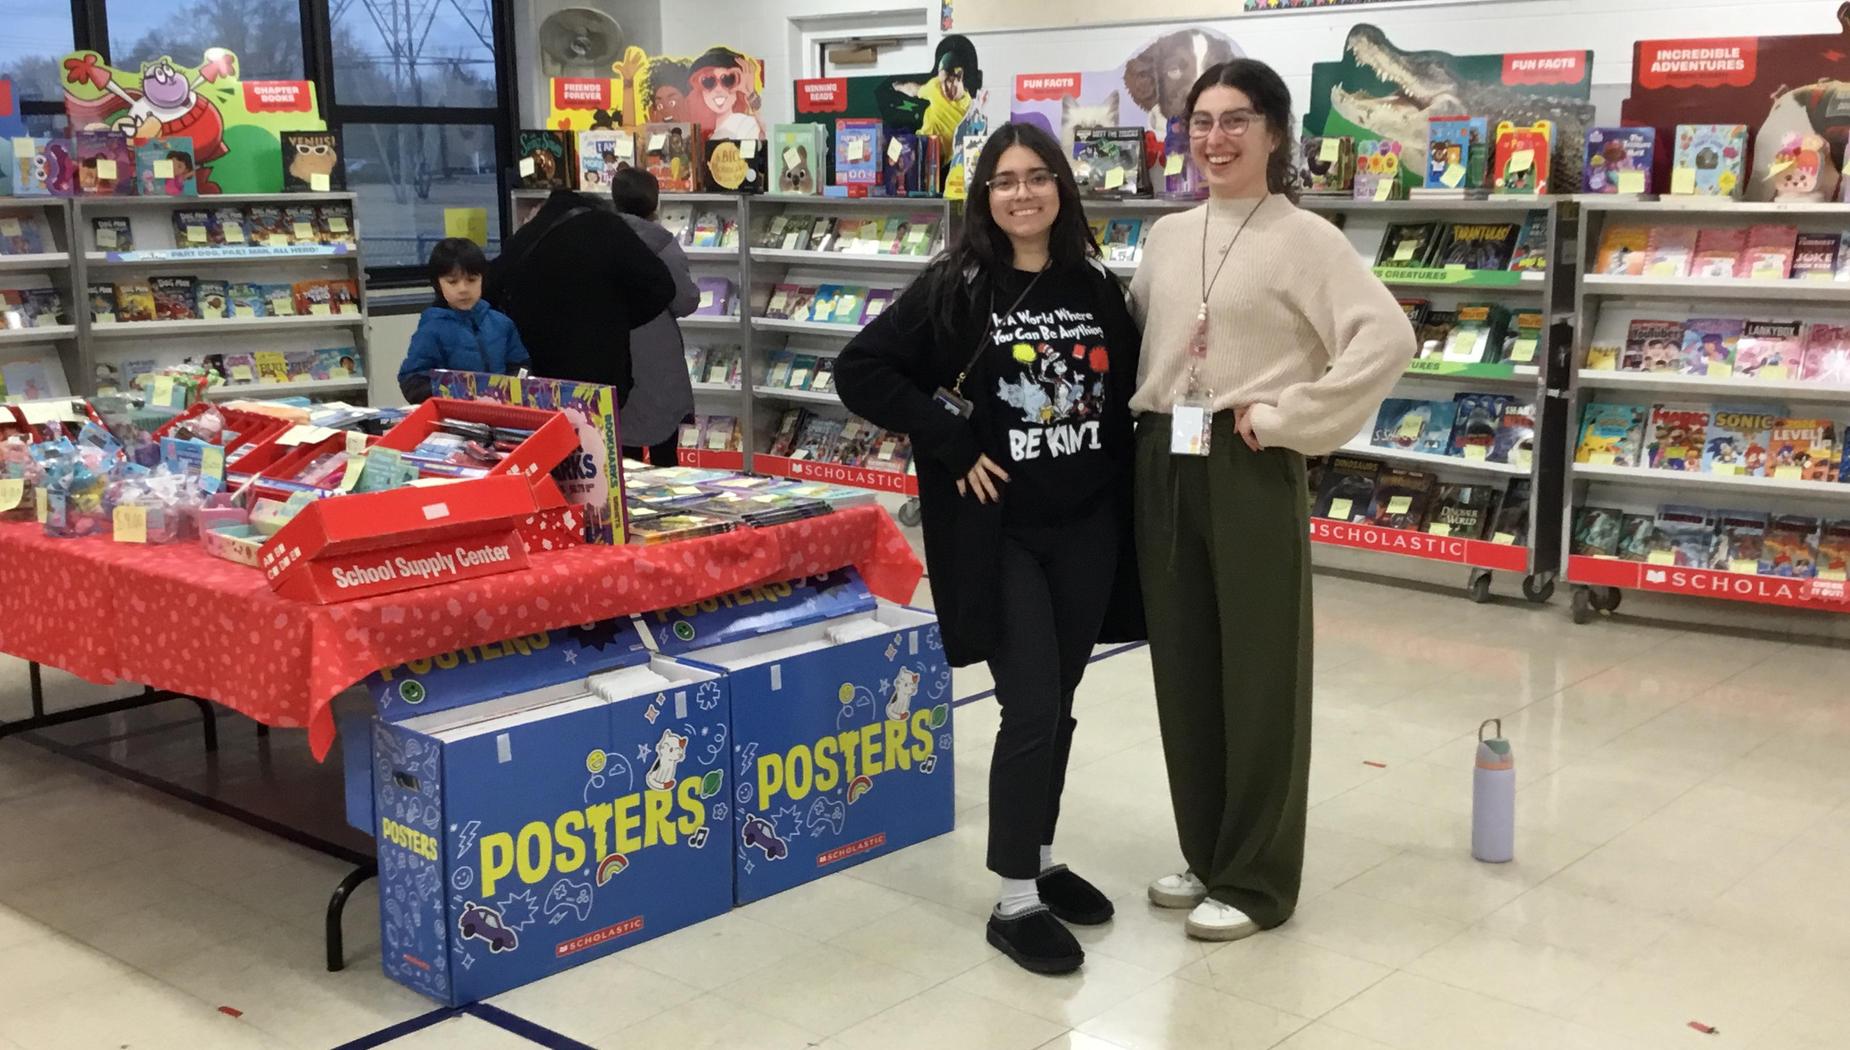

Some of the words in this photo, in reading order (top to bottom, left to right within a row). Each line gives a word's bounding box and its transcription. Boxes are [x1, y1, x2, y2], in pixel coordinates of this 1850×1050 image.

[1656, 48, 1741, 60] INCREDIBLE
[1512, 59, 1534, 70] FUN
[1535, 57, 1576, 69] FACTS
[1651, 59, 1745, 73] ADVENTURES
[254, 86, 300, 95] CHAPTER
[564, 83, 601, 92] FRIENDS
[804, 83, 837, 93] WINNING
[1023, 80, 1043, 89] FUN
[1044, 78, 1074, 88] FACTS
[261, 94, 295, 103] BOOKS
[564, 91, 602, 100] FOREVER
[1384, 270, 1448, 280] CREATURES
[1006, 314, 1017, 326] A
[1016, 309, 1055, 326] World
[1054, 307, 1094, 322] Where
[992, 328, 1014, 346] You
[1014, 327, 1041, 341] Can
[1039, 325, 1058, 341] Be
[1059, 324, 1104, 341] Anything
[1714, 411, 1774, 429] SONIC
[1773, 428, 1818, 441] LEVEL
[604, 414, 618, 489] BOOKMARKS
[1008, 427, 1043, 462] BE
[804, 464, 904, 490] SCHOLASTIC
[1319, 524, 1463, 557] SCHOLASTIC
[332, 559, 397, 589] School
[394, 551, 457, 579] Supply
[455, 544, 511, 568] Center
[757, 708, 936, 811] POSTERS
[382, 816, 438, 862] POSTERS
[479, 775, 706, 898] POSTERS
[827, 835, 884, 860] SCHOLASTIC
[569, 919, 641, 951] SCHOLASTIC
